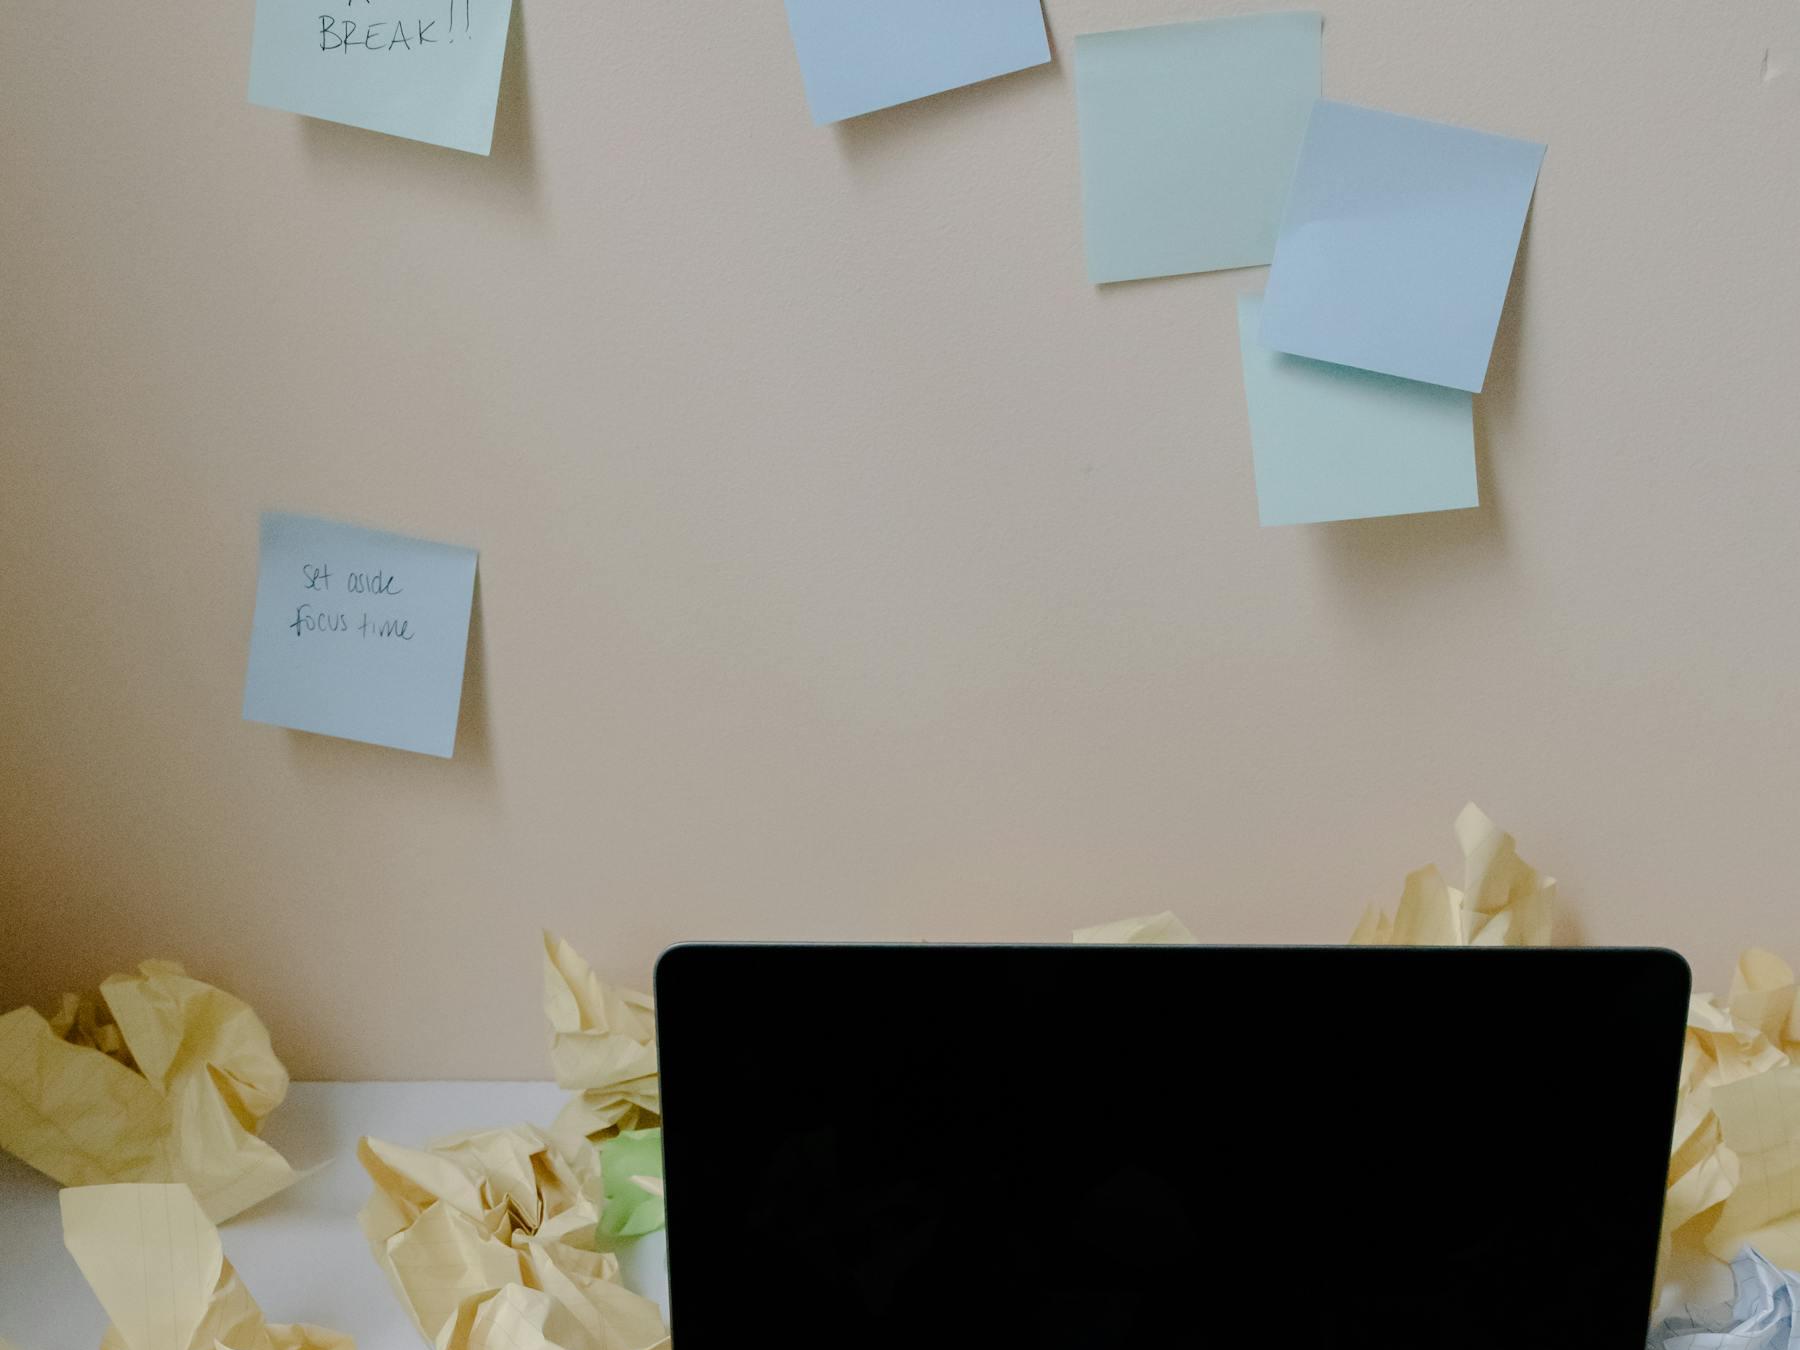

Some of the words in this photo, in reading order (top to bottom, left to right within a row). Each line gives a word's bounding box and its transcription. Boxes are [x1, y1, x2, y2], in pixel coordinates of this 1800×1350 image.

[318, 0, 473, 54] BREAK!!
[347, 567, 403, 595] aside
[358, 612, 415, 640] time
